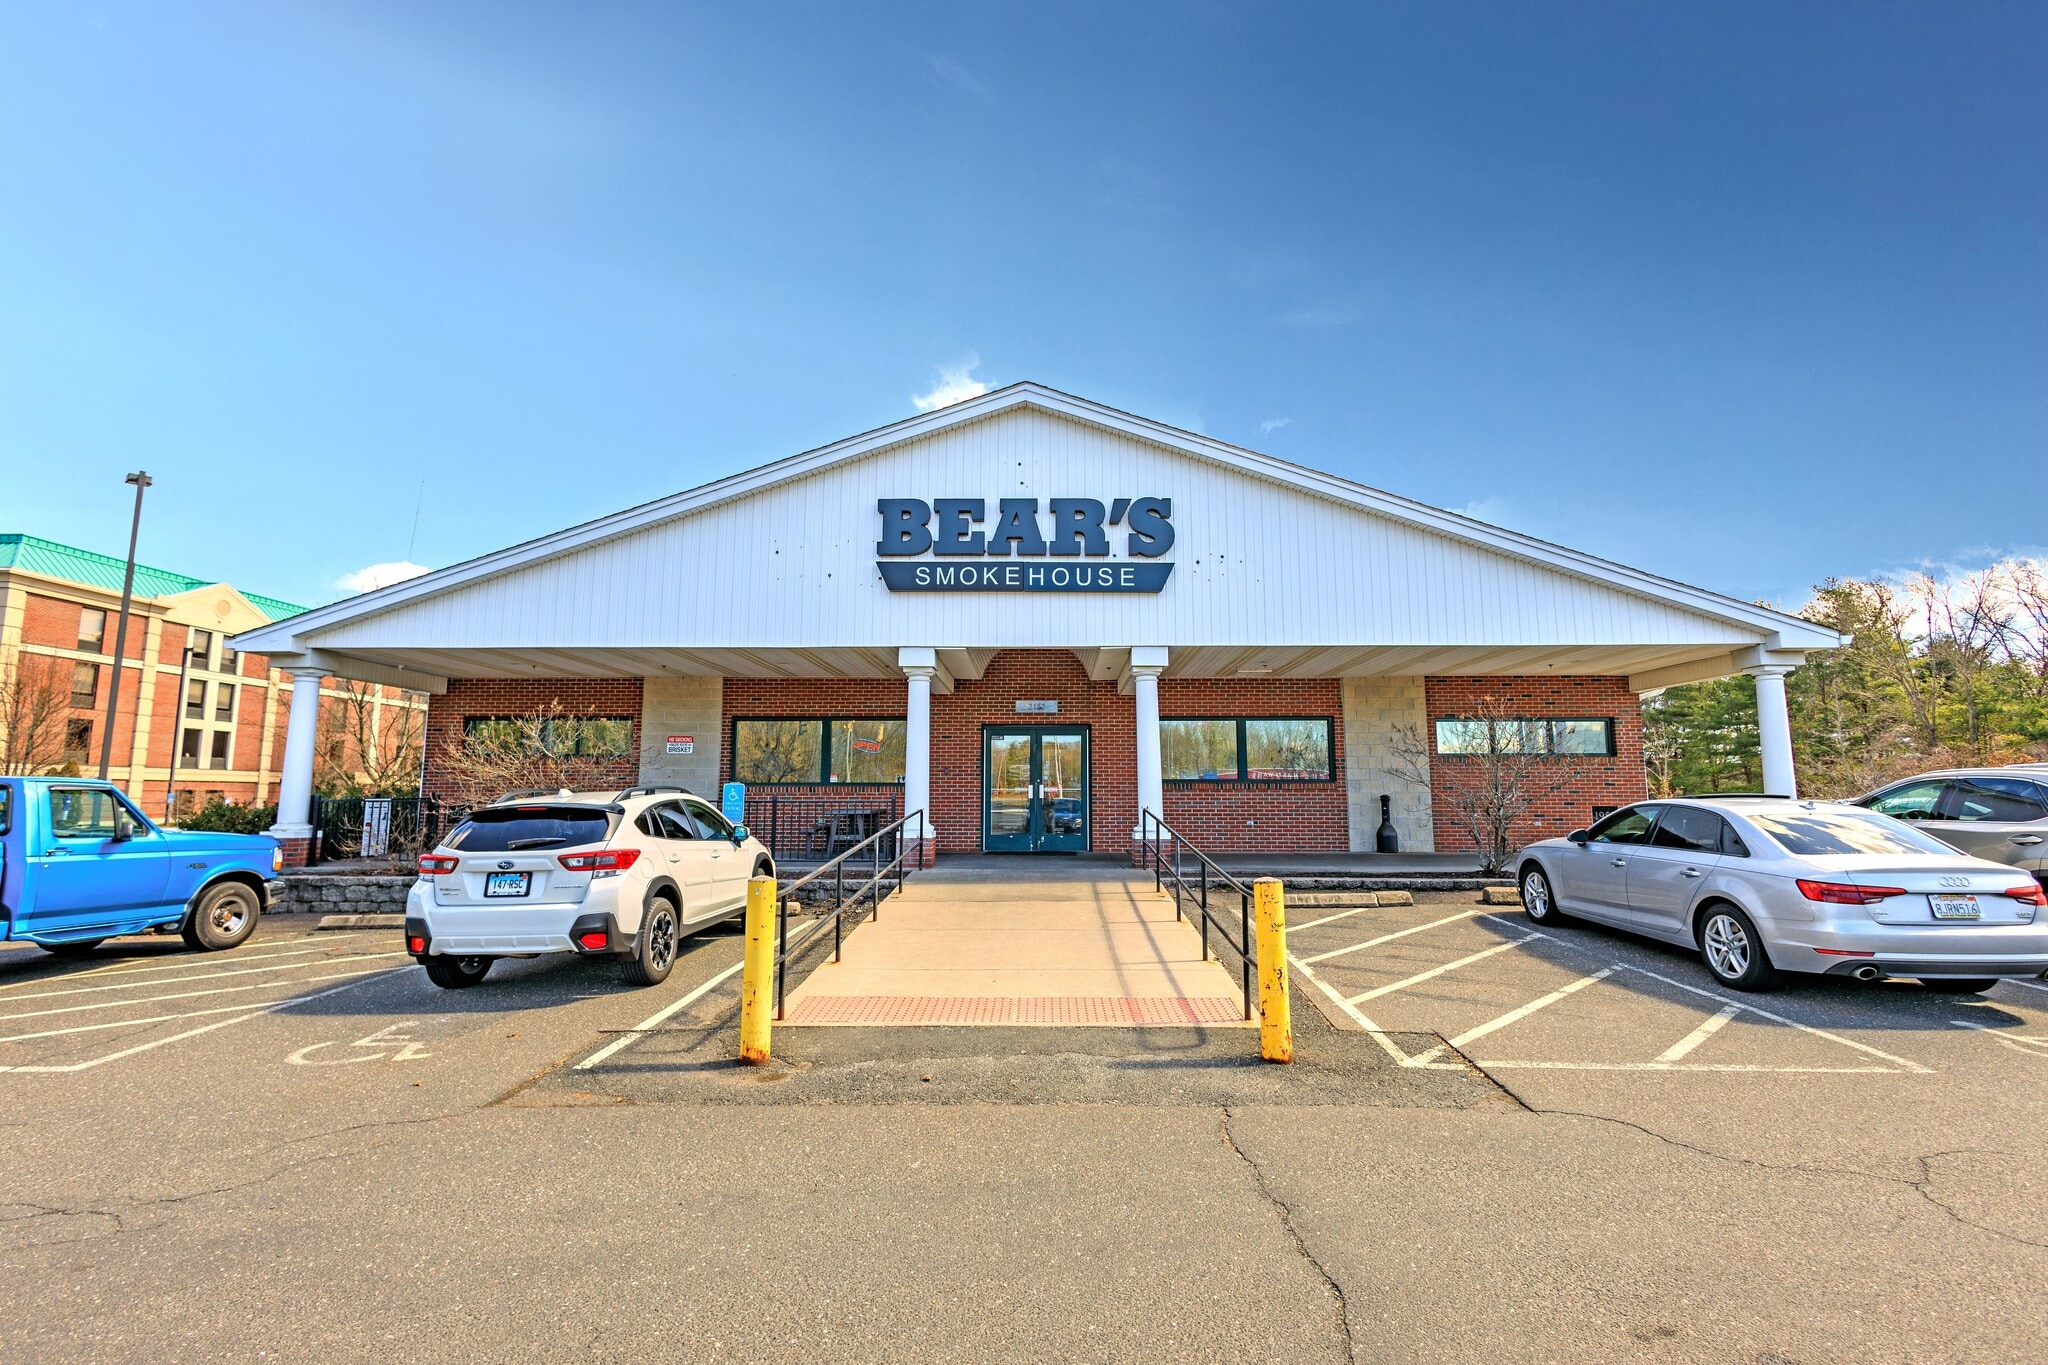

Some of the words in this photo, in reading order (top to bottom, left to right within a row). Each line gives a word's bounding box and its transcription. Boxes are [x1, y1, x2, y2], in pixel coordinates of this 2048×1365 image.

[876, 497, 1176, 558] BEAR'S
[915, 566, 1136, 587] SMOKEHOUSE
[853, 740, 880, 752] OPEN
[1935, 903, 1978, 915] 8JRN516
